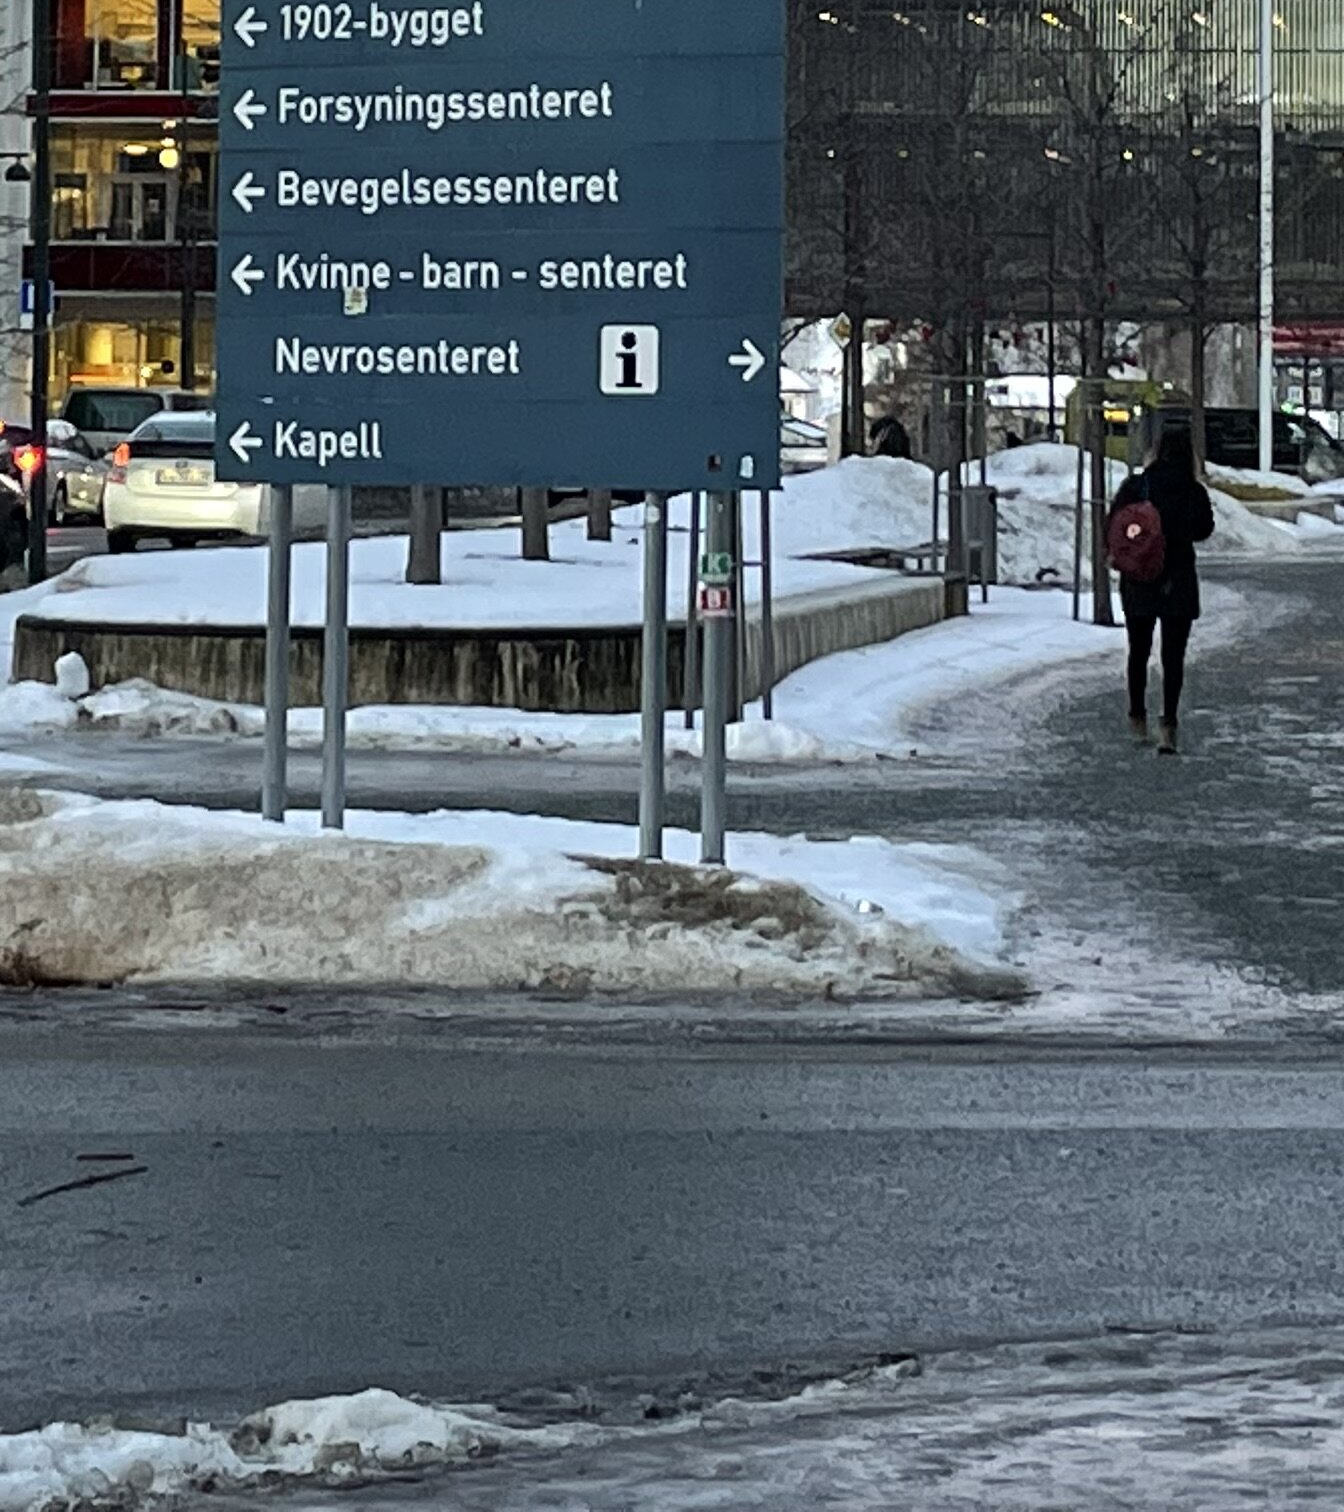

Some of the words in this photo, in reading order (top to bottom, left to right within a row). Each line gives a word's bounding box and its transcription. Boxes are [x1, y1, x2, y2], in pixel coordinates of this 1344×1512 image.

[280, 1, 484, 47] 1902-bygget
[279, 82, 613, 131] Forsyningssenteret
[278, 168, 619, 215] Bevegelsessenteret
[277, 253, 391, 289] Kvinne
[423, 252, 500, 289] barn
[539, 253, 688, 289] senteret
[275, 337, 521, 375] Nevrosenteret
[274, 421, 383, 467] Kapell
